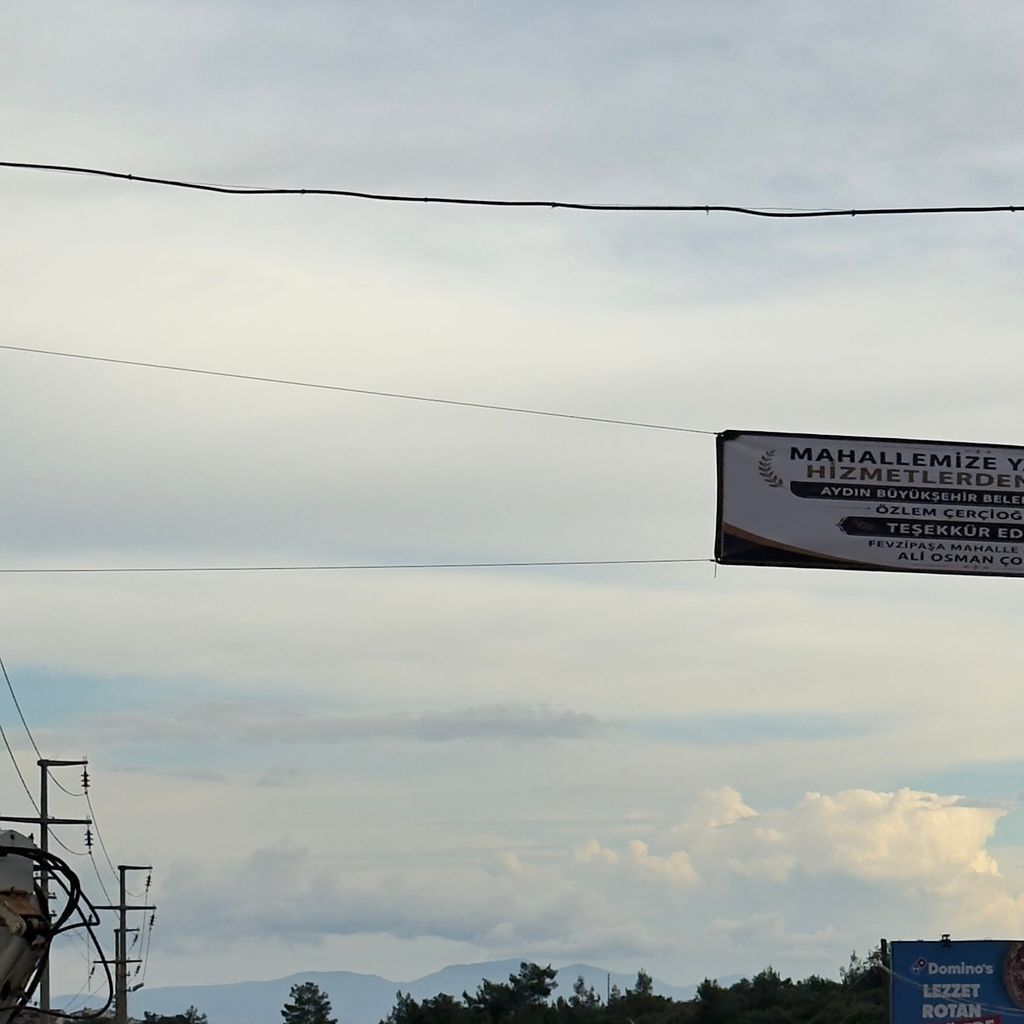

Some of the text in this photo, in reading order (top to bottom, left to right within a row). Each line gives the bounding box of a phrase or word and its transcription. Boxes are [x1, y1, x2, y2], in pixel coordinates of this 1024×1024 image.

[790, 446, 997, 470] MAHALLEMİZE
[821, 486, 871, 497] AYDIN
[877, 487, 977, 503] BÜYÜKŞEHİR
[876, 504, 937, 516] ÖZLEM
[887, 522, 990, 538] TEŞEKKÜR
[950, 543, 1019, 554] MAHALLE
[897, 551, 924, 561] ALİ
[931, 552, 994, 564] OSMAN
[928, 962, 994, 975] Domino's
[923, 984, 980, 998] LEZZET
[922, 1003, 981, 1018] ROTAN
